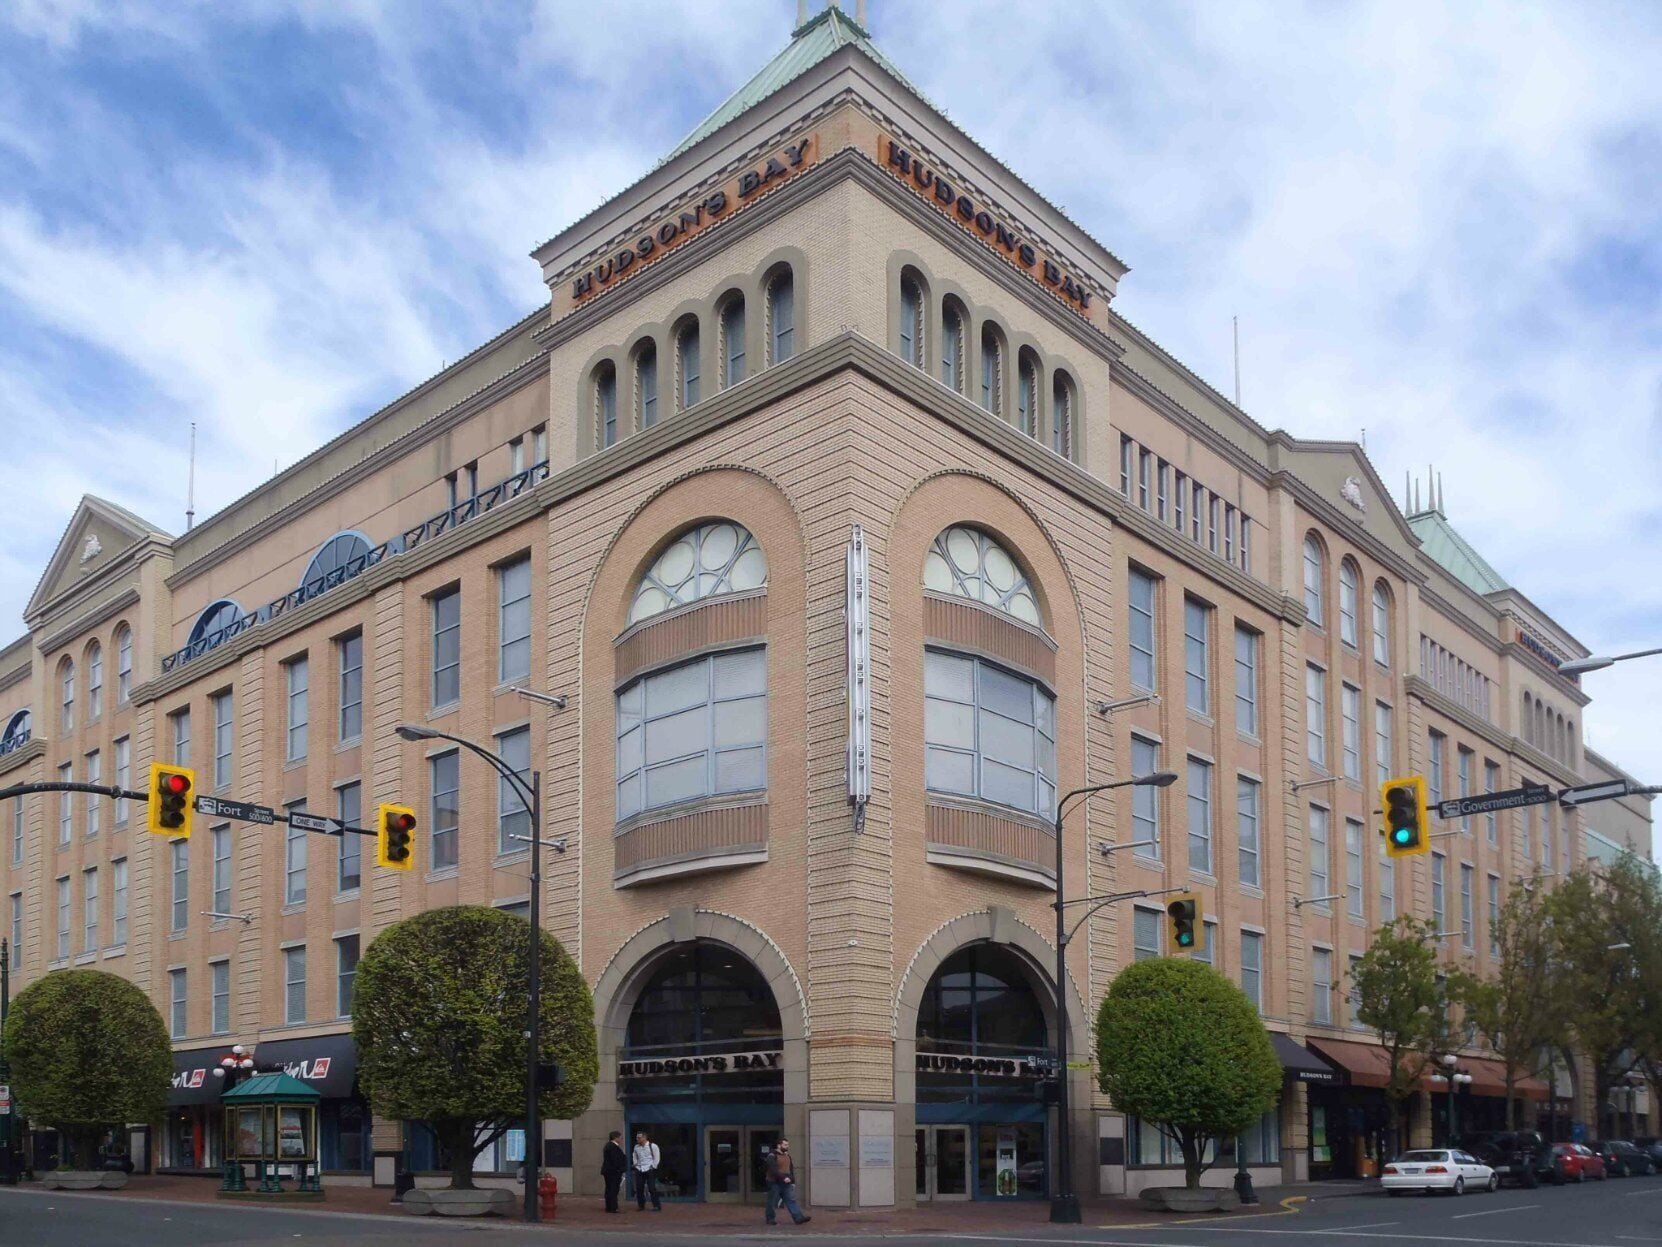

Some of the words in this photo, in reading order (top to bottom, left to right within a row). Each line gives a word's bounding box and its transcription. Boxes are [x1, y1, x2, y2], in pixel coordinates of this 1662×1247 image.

[572, 189, 727, 300] HUDSON'S
[738, 136, 810, 199] BAY
[886, 139, 1038, 268] HUDSON'S
[1043, 258, 1092, 309] BAY
[217, 802, 242, 817] Fort
[1461, 794, 1526, 814] Government
[296, 816, 311, 826] ONE
[312, 820, 326, 829] WAY
[619, 1057, 728, 1076] HUDSON'S
[733, 1053, 782, 1069] BAY
[915, 1055, 1016, 1074] HUDSON'S
[1036, 1057, 1048, 1066] Fort
